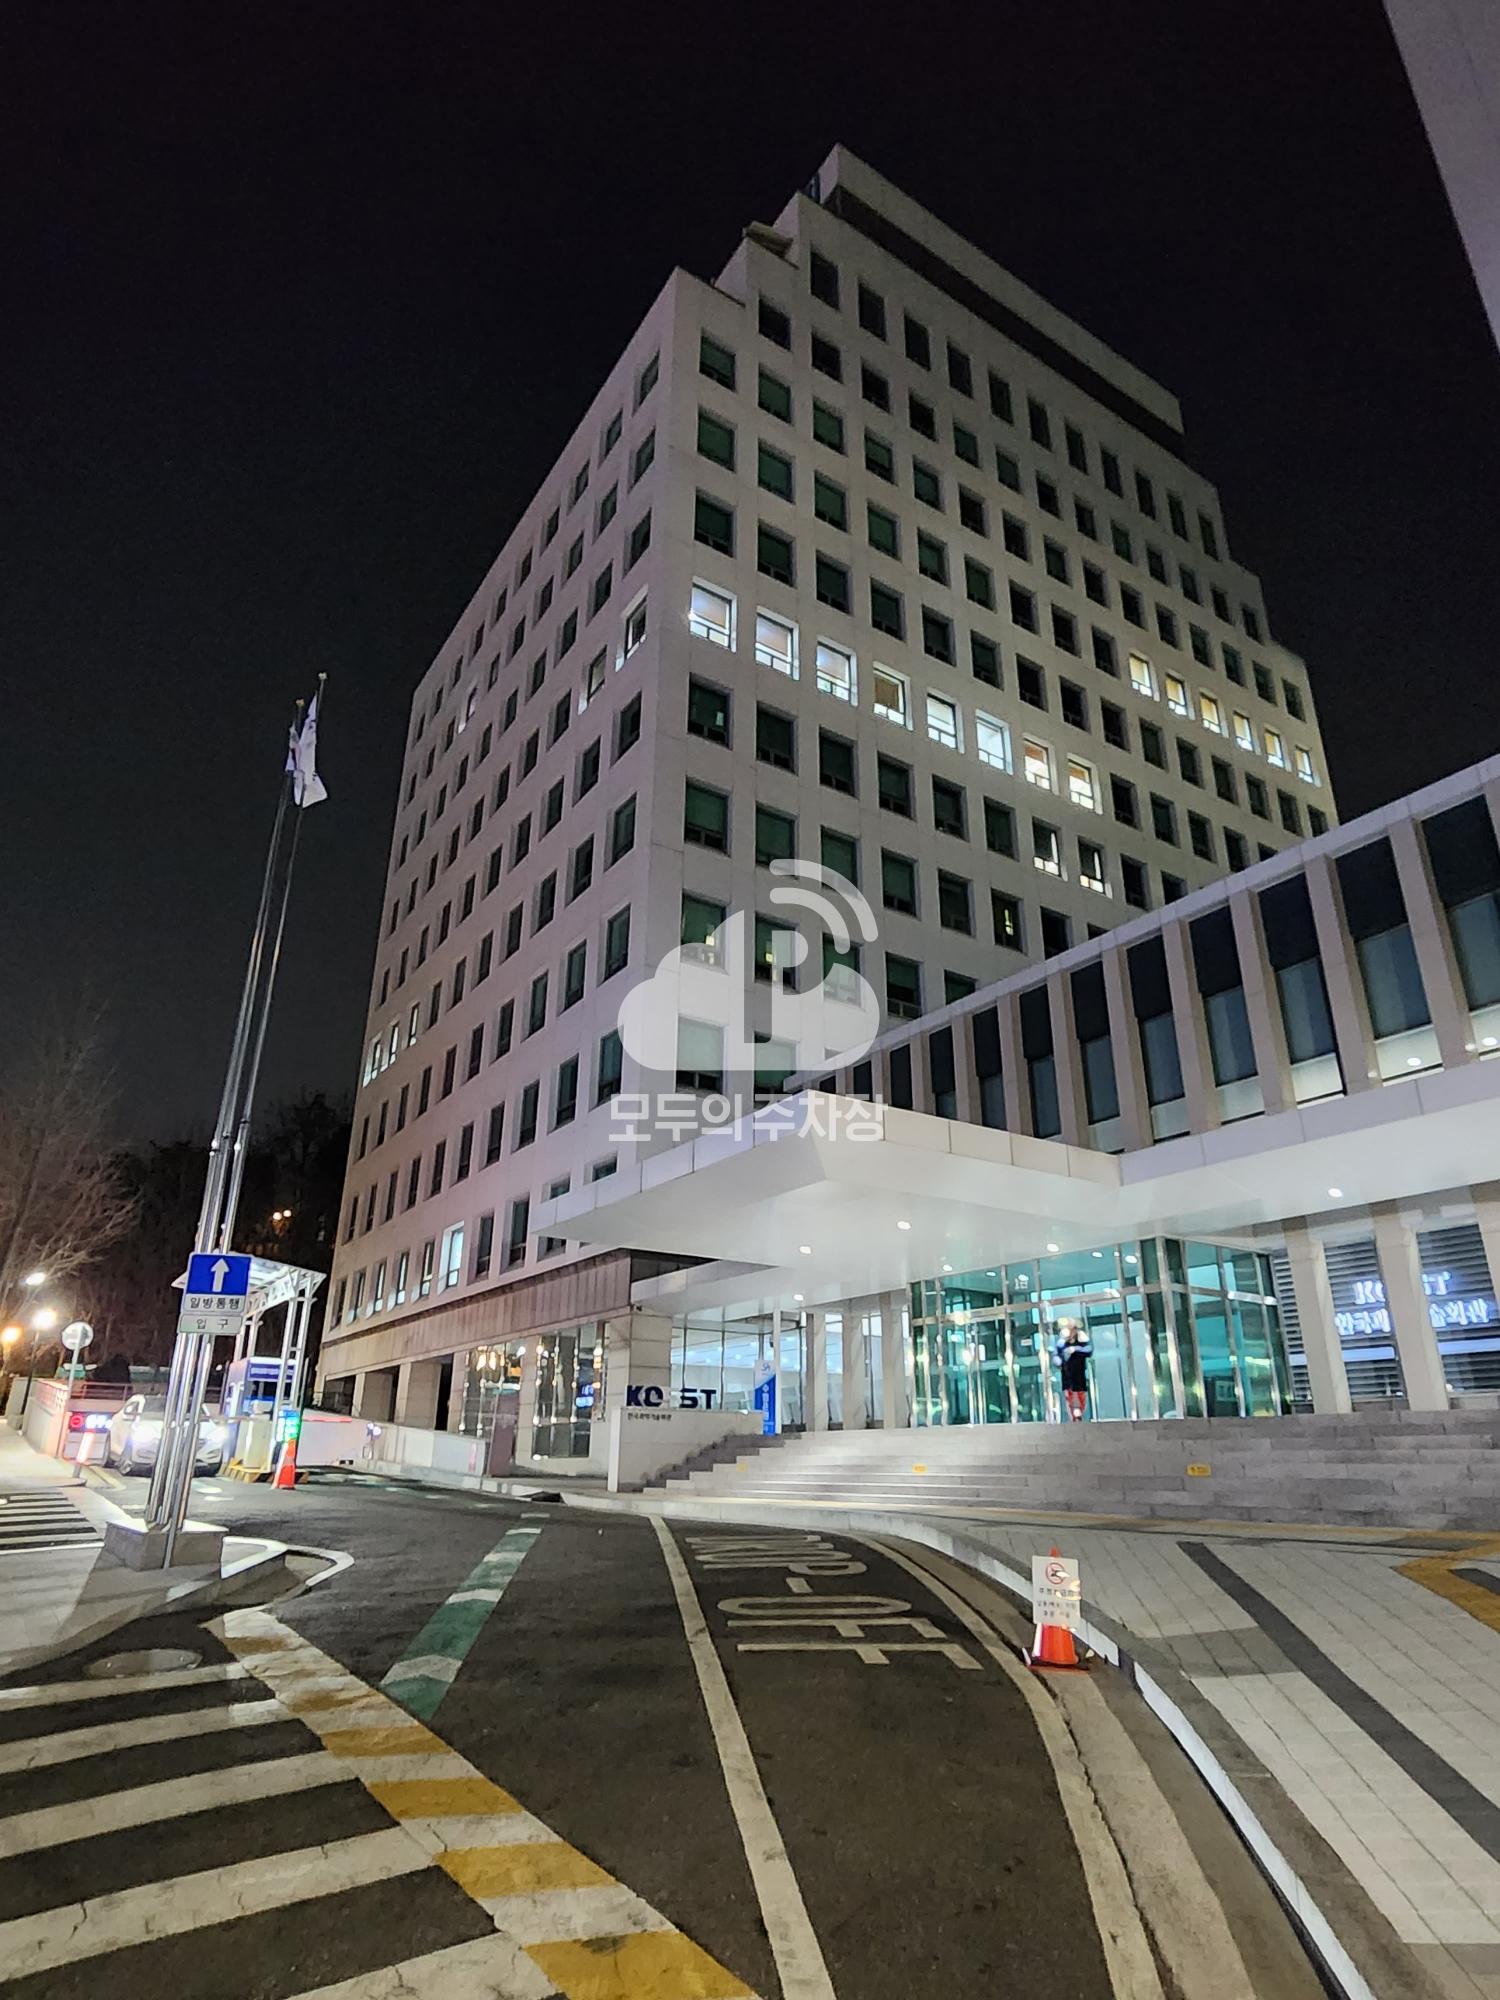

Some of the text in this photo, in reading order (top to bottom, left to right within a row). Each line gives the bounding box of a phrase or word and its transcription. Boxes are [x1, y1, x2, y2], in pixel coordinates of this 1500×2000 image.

[190, 1297, 240, 1310] 일방통행
[626, 1385, 717, 1410] KOST
[685, 1534, 985, 1671] DROP-OFF
